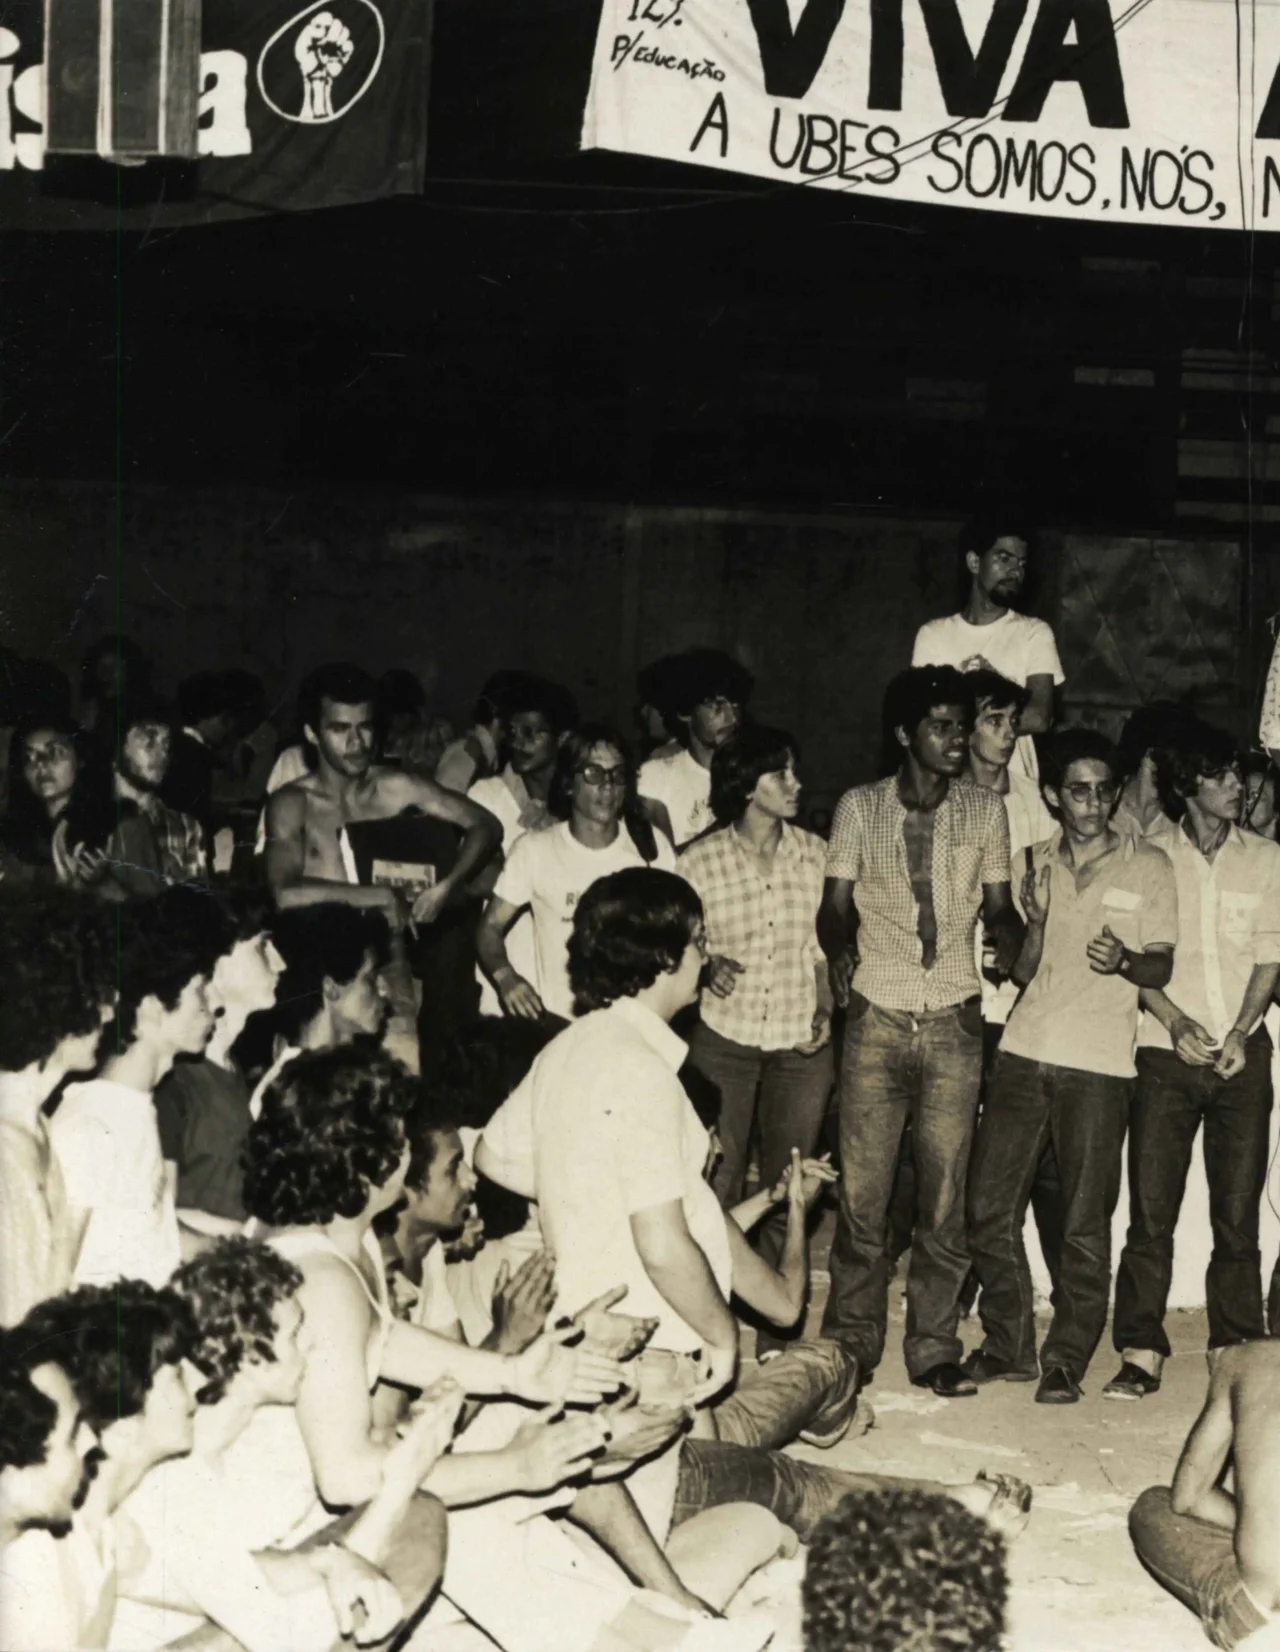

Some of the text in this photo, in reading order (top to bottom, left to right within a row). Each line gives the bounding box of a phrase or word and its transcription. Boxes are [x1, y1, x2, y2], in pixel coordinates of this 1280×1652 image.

[746, 0, 1130, 128] VIVA
[689, 91, 729, 158] A
[769, 107, 901, 185] UBES
